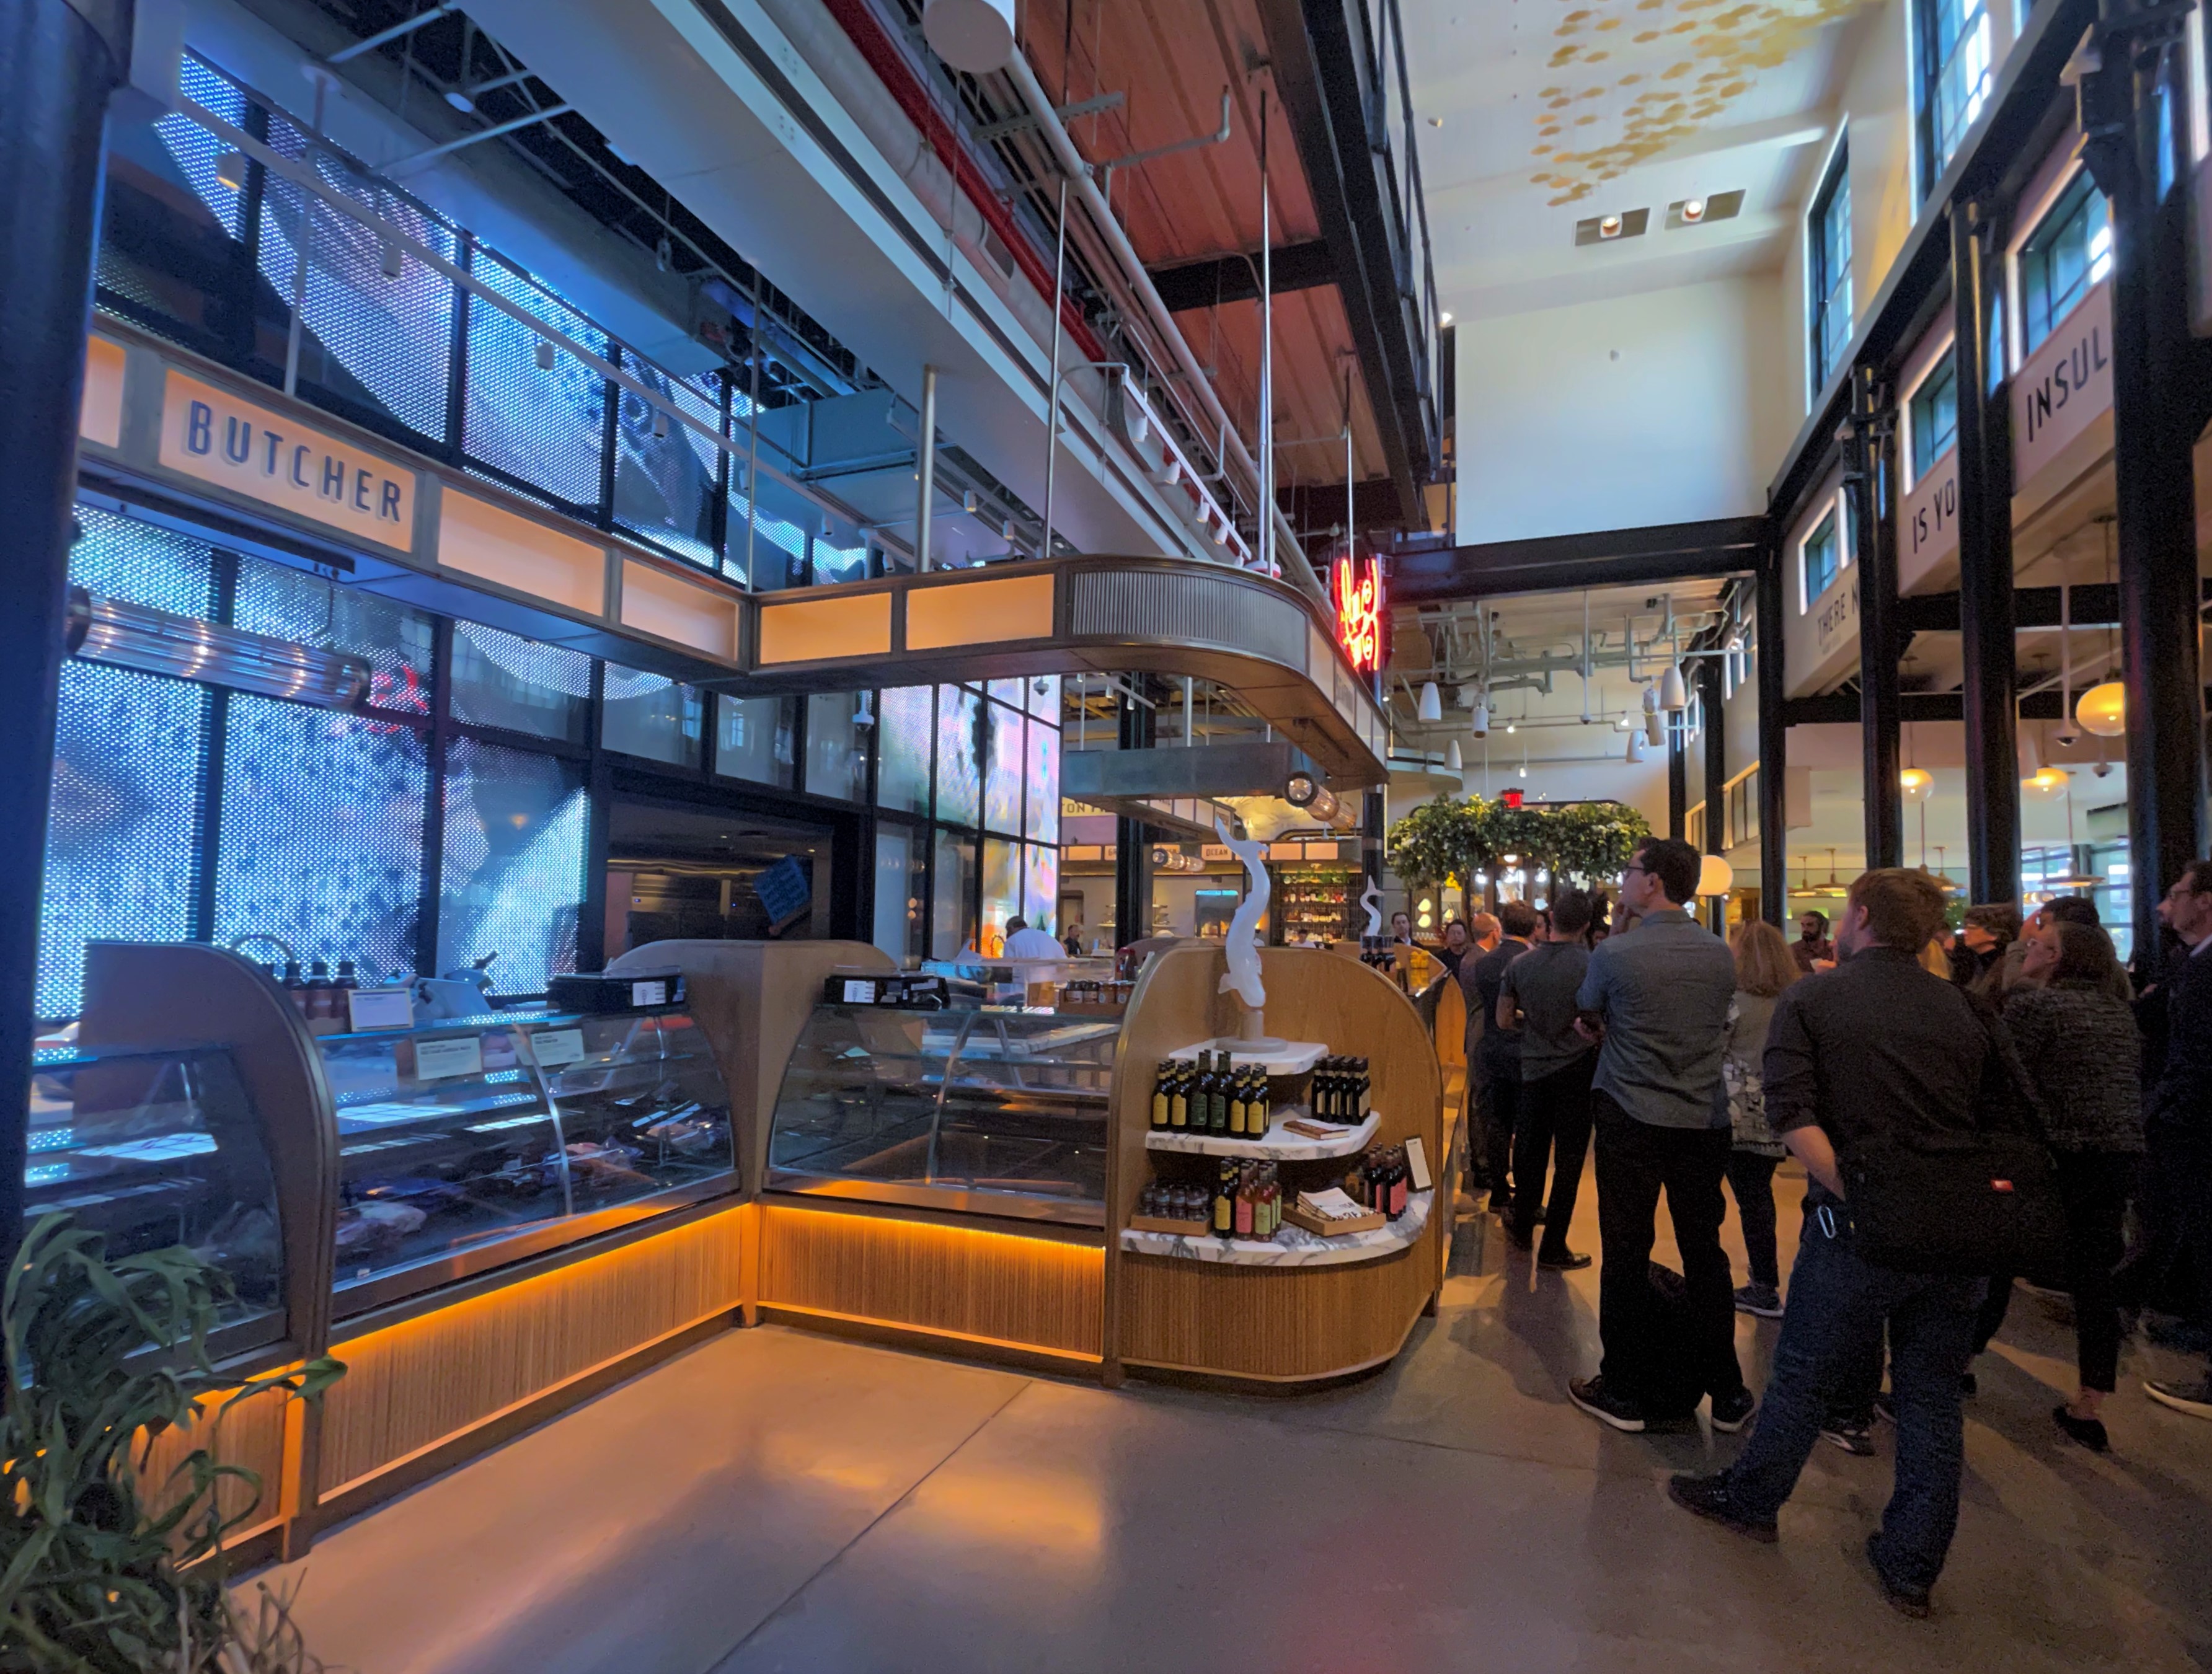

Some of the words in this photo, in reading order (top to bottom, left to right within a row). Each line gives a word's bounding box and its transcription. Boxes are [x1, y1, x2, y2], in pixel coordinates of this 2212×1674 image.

[2026, 326, 2107, 443] INSUL
[188, 400, 400, 522] BUTCHER
[1913, 507, 1927, 554] IS
[1206, 848, 1228, 857] OCEAN
